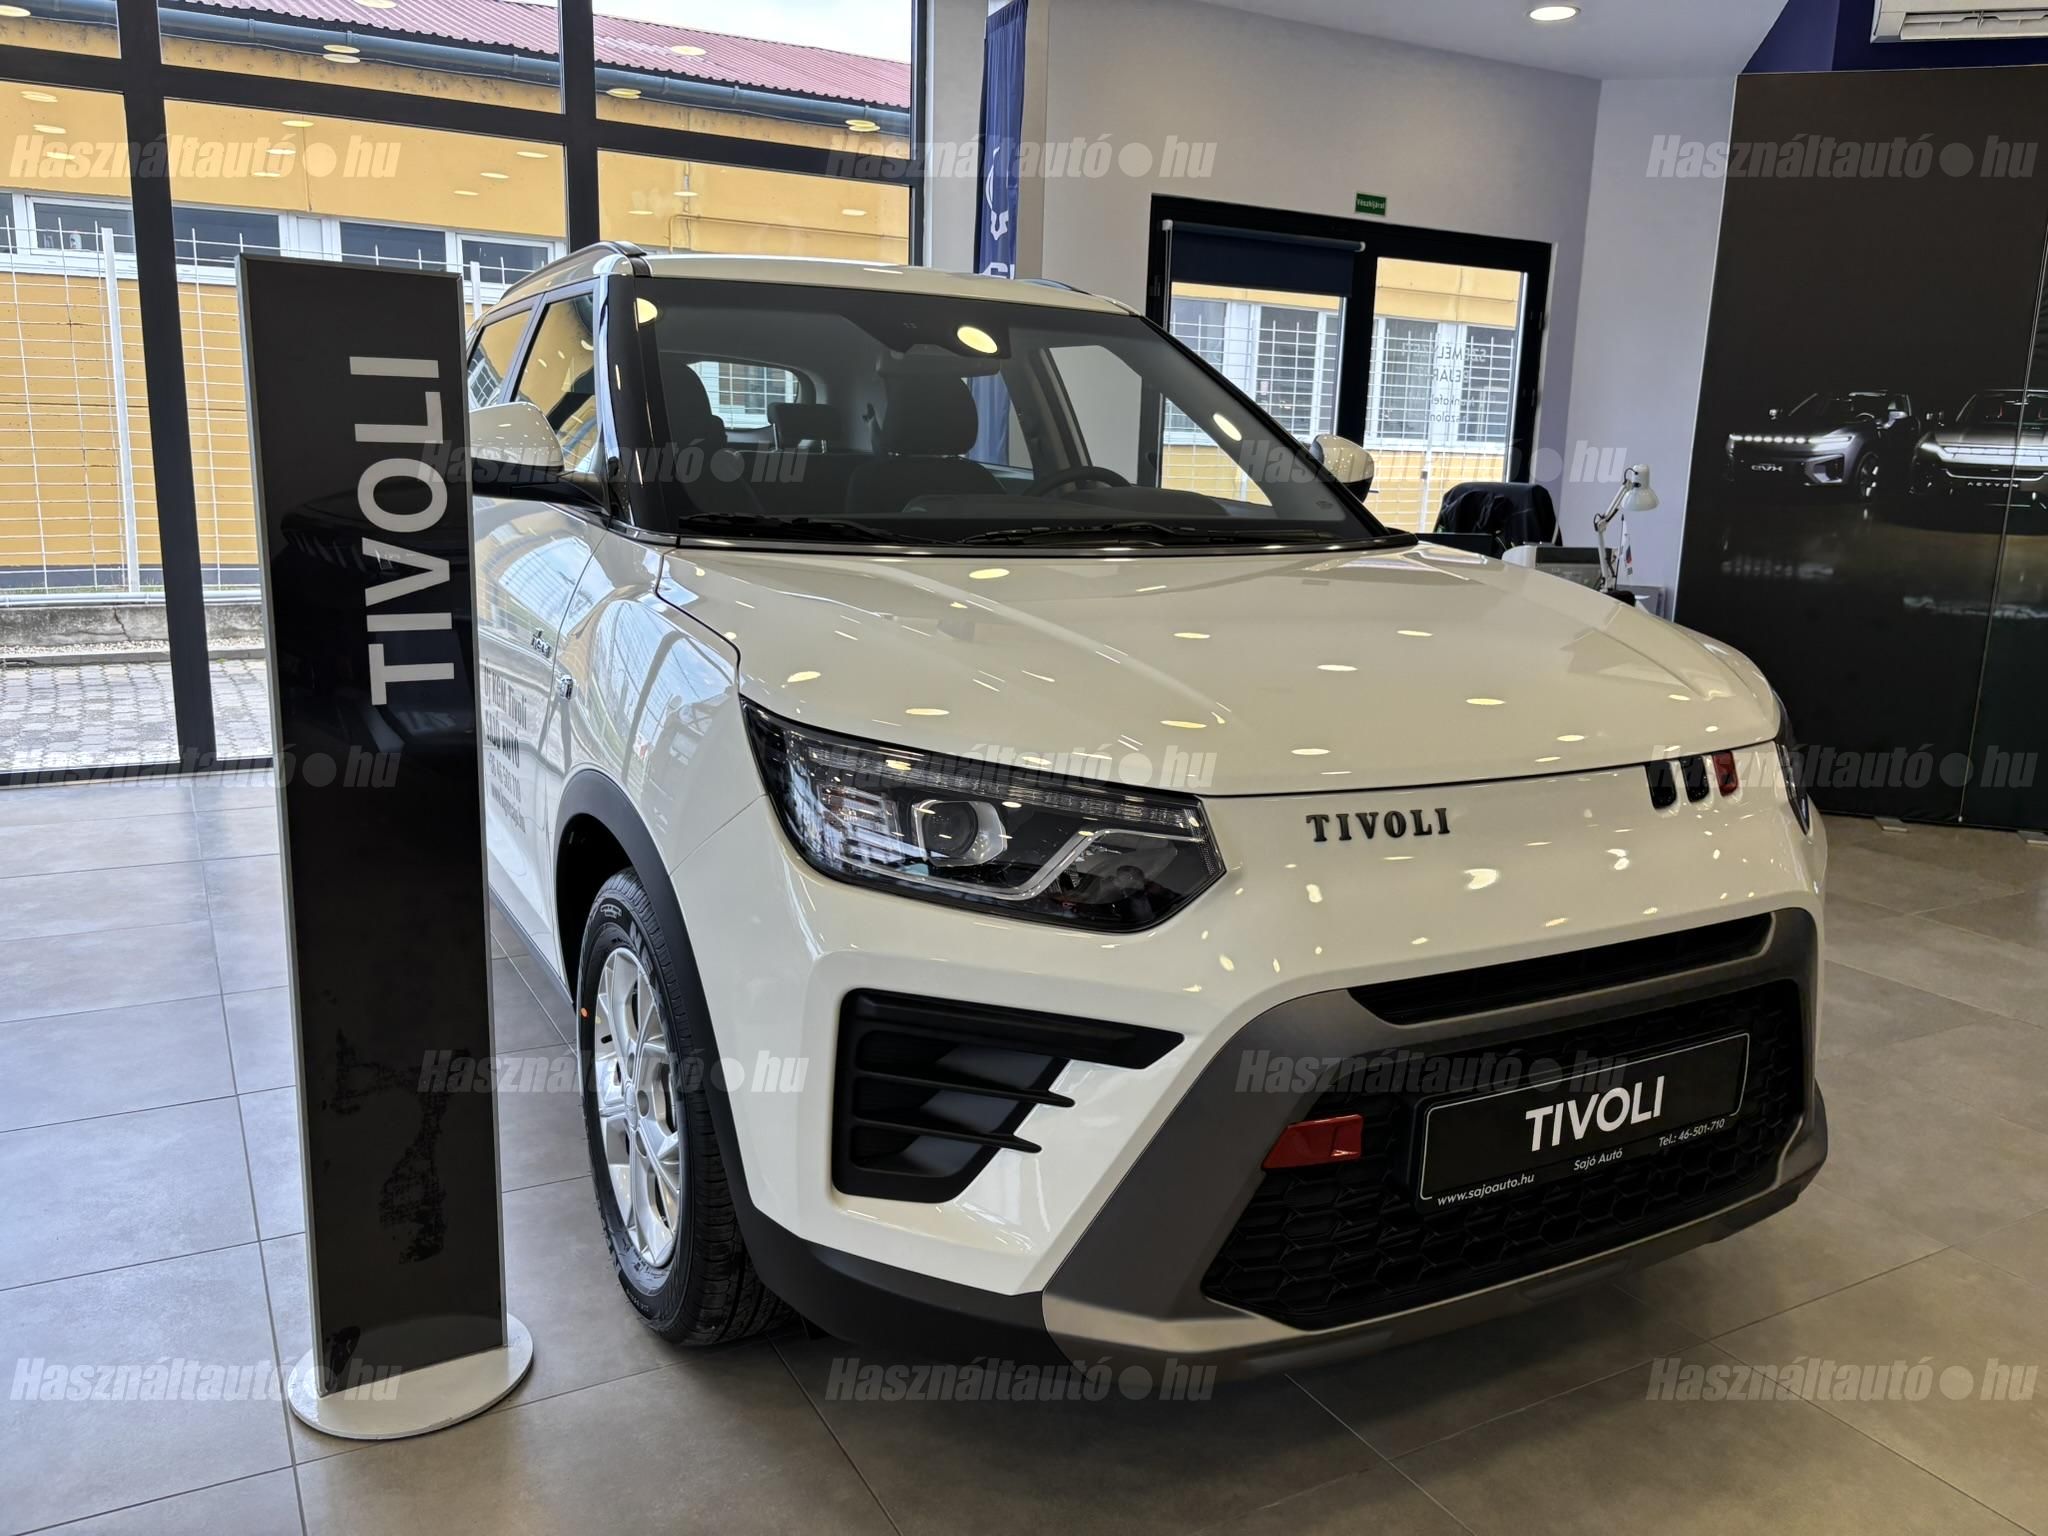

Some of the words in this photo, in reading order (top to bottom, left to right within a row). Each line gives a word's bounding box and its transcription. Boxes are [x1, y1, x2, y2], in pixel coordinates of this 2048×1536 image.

[349, 356, 455, 705] TIVOLI
[1305, 807, 1451, 842] TIVOLI
[1525, 1075, 1665, 1152] TIVOLI
[1677, 1118, 1726, 1143] 46-501-710
[1573, 1155, 1597, 1172] Sajó
[1597, 1147, 1623, 1165] Autó
[1437, 1172, 1535, 1206] www.sajoauto.hu
